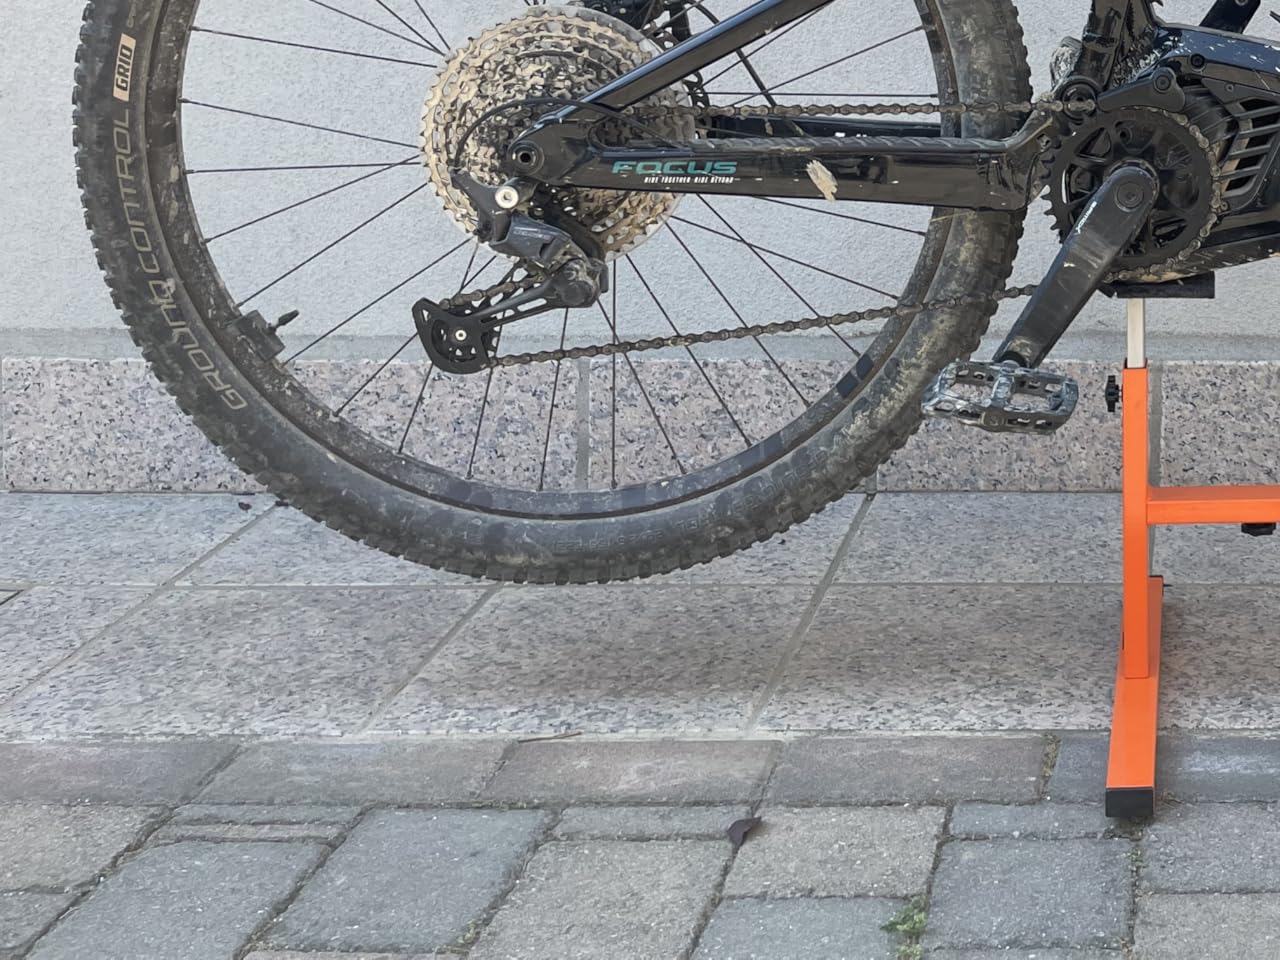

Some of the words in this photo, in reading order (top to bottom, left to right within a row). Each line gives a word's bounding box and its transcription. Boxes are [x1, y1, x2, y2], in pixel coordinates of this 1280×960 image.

[115, 43, 133, 92] GRID
[113, 107, 160, 273] CONTROL
[611, 161, 738, 174] FOCUS
[149, 279, 247, 410] GROUND
